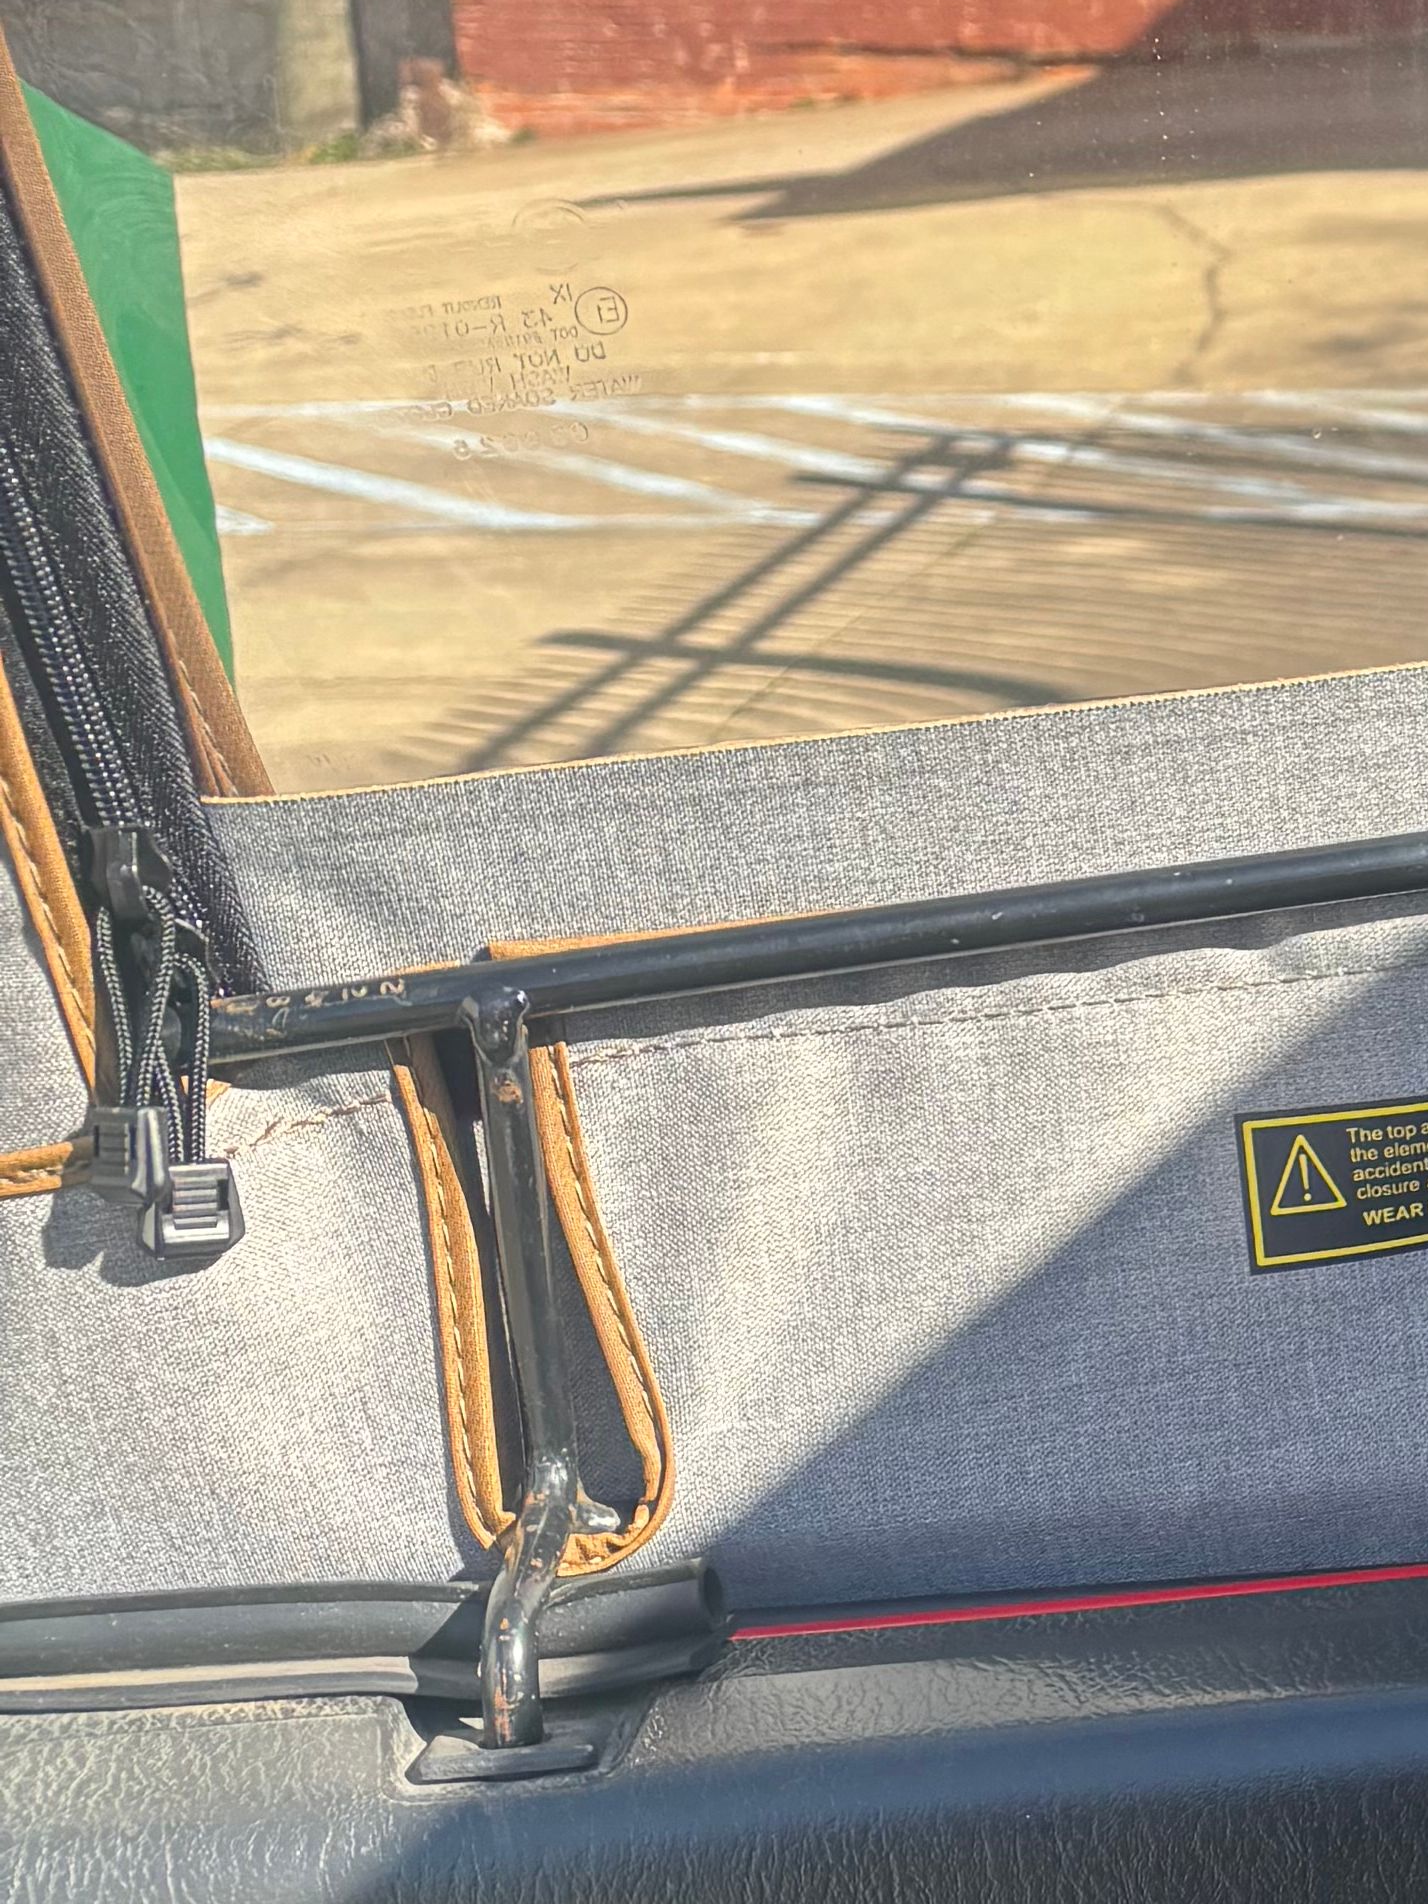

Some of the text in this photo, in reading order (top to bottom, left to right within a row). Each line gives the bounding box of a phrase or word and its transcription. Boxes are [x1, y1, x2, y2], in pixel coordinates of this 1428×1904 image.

[1346, 1127, 1383, 1144] The
[1387, 1124, 1417, 1140] top
[1350, 1147, 1379, 1163] the
[1356, 1180, 1420, 1200] closure
[1362, 1202, 1424, 1226] WEAR
